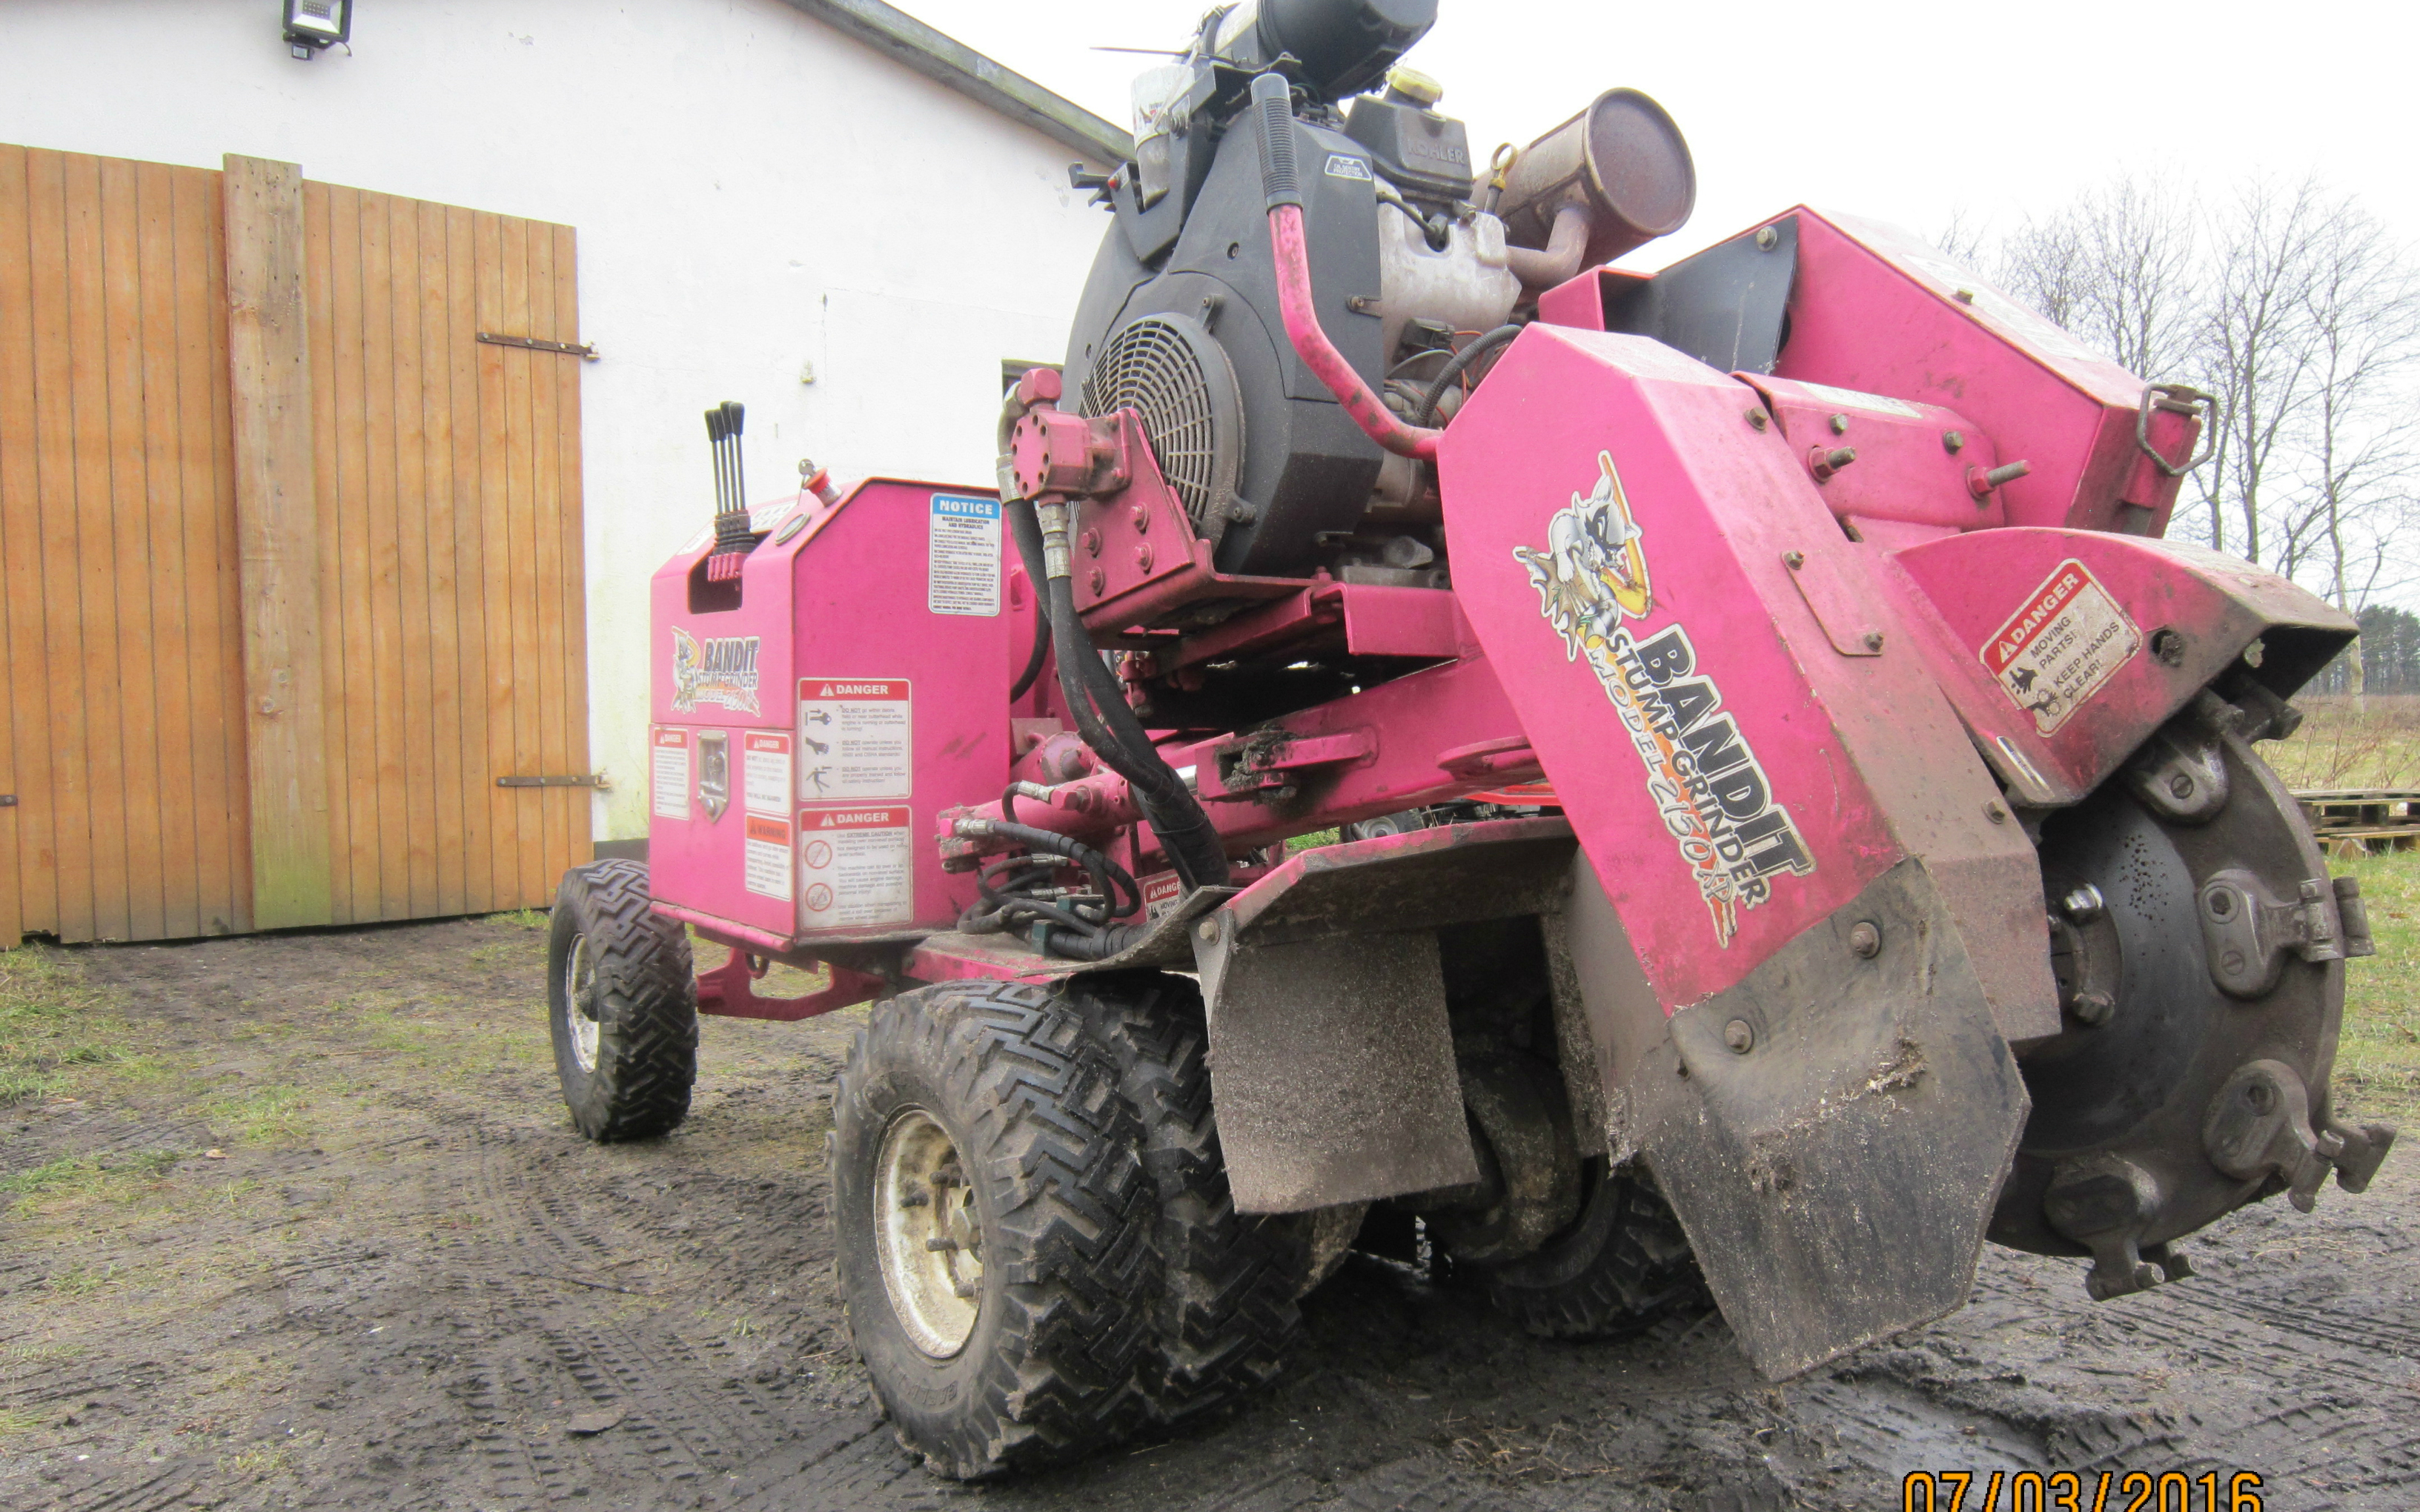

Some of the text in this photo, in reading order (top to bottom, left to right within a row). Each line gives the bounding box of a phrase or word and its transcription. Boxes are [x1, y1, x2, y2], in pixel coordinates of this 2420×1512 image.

[1409, 141, 1465, 166] KOHLER
[940, 500, 992, 515] NOTICE
[2011, 573, 2079, 645] DANGER
[704, 640, 759, 672] BANDIT
[2030, 616, 2071, 658] MOVING
[2039, 631, 2077, 669] PARTS!
[2054, 622, 2120, 688] KEEP HANDS
[836, 685, 889, 694] DANGER
[2063, 658, 2101, 699] CLEAR!
[1589, 649, 1666, 772] MODEL
[1606, 633, 1768, 903] STUMP GRINDER
[1637, 630, 1811, 875] BANDIT
[758, 825, 786, 839] WARNING
[837, 812, 889, 823] DANGER
[1157, 881, 1181, 895] DANGE
